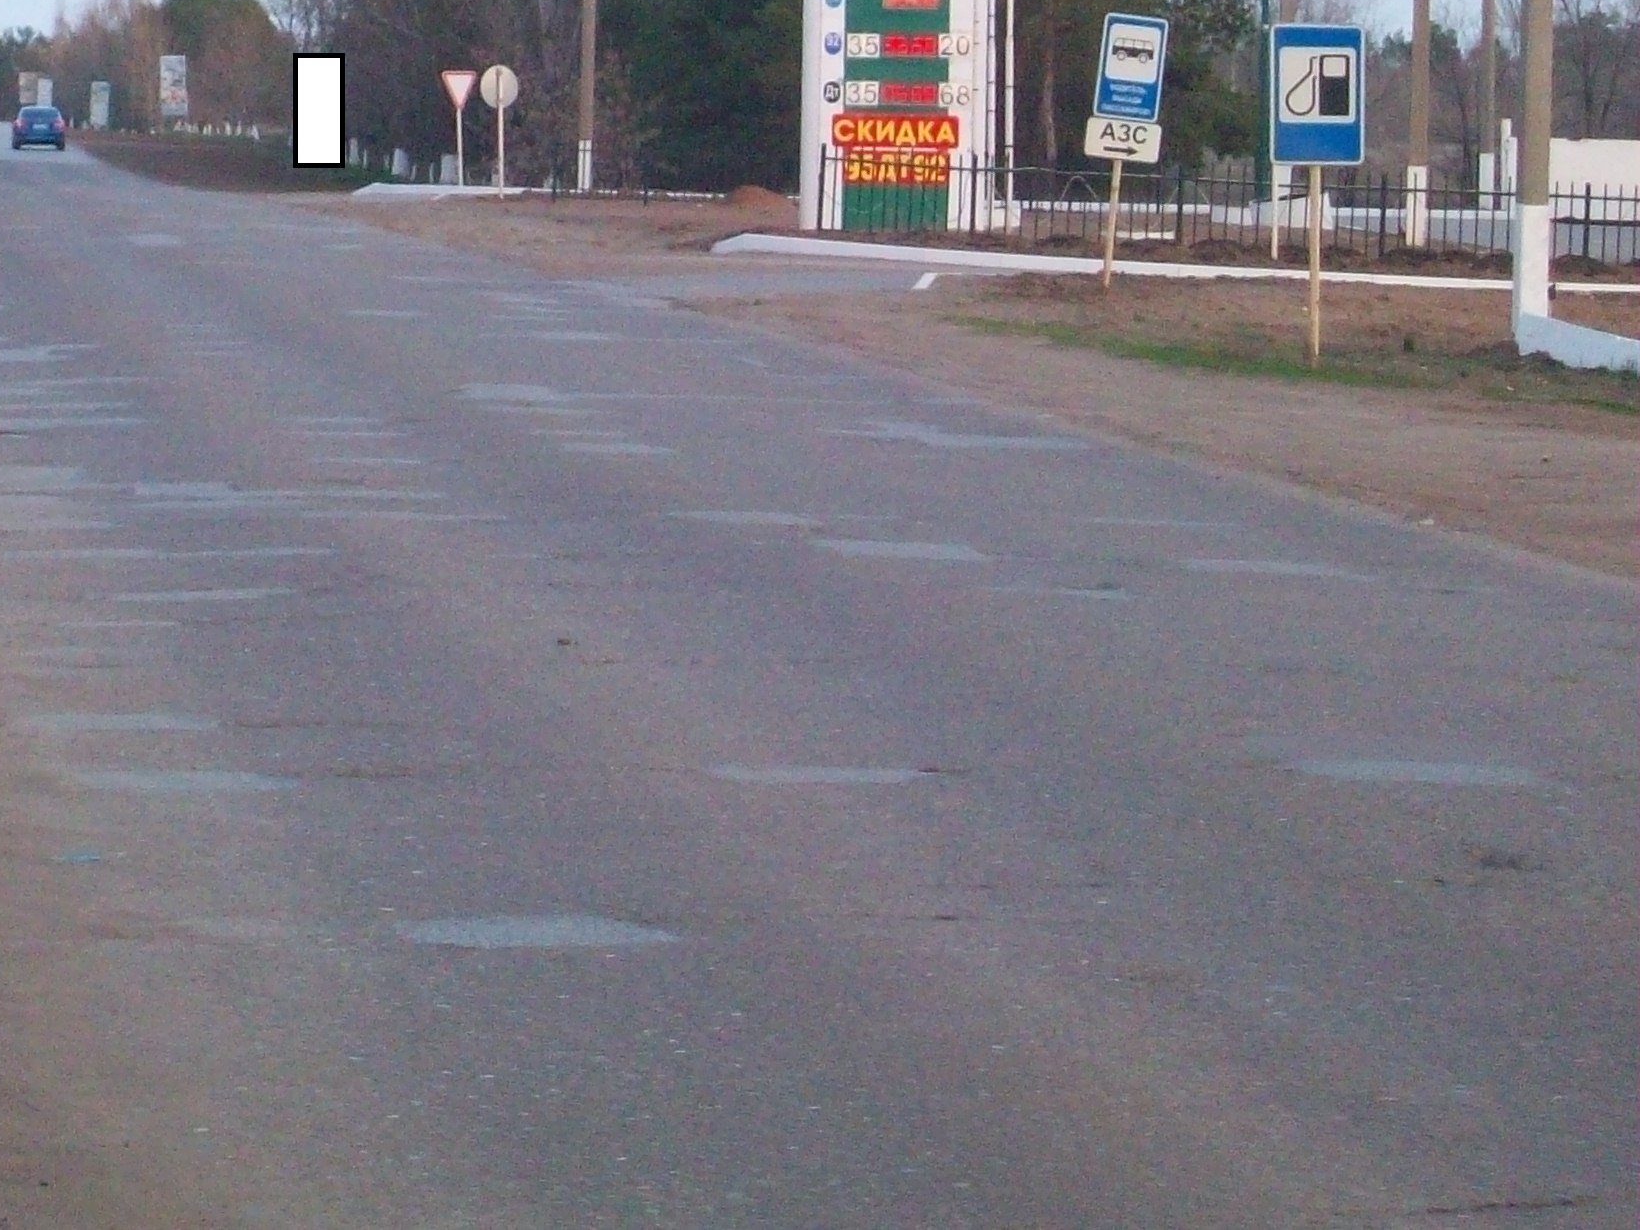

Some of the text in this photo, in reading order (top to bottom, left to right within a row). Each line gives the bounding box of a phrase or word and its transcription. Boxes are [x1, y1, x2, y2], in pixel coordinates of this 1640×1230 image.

[848, 36, 878, 56] 35
[940, 36, 970, 56] 20
[847, 83, 877, 104] 35
[940, 86, 970, 105] 68
[834, 119, 955, 146] СКИДКА
[1100, 122, 1147, 145] АЗС
